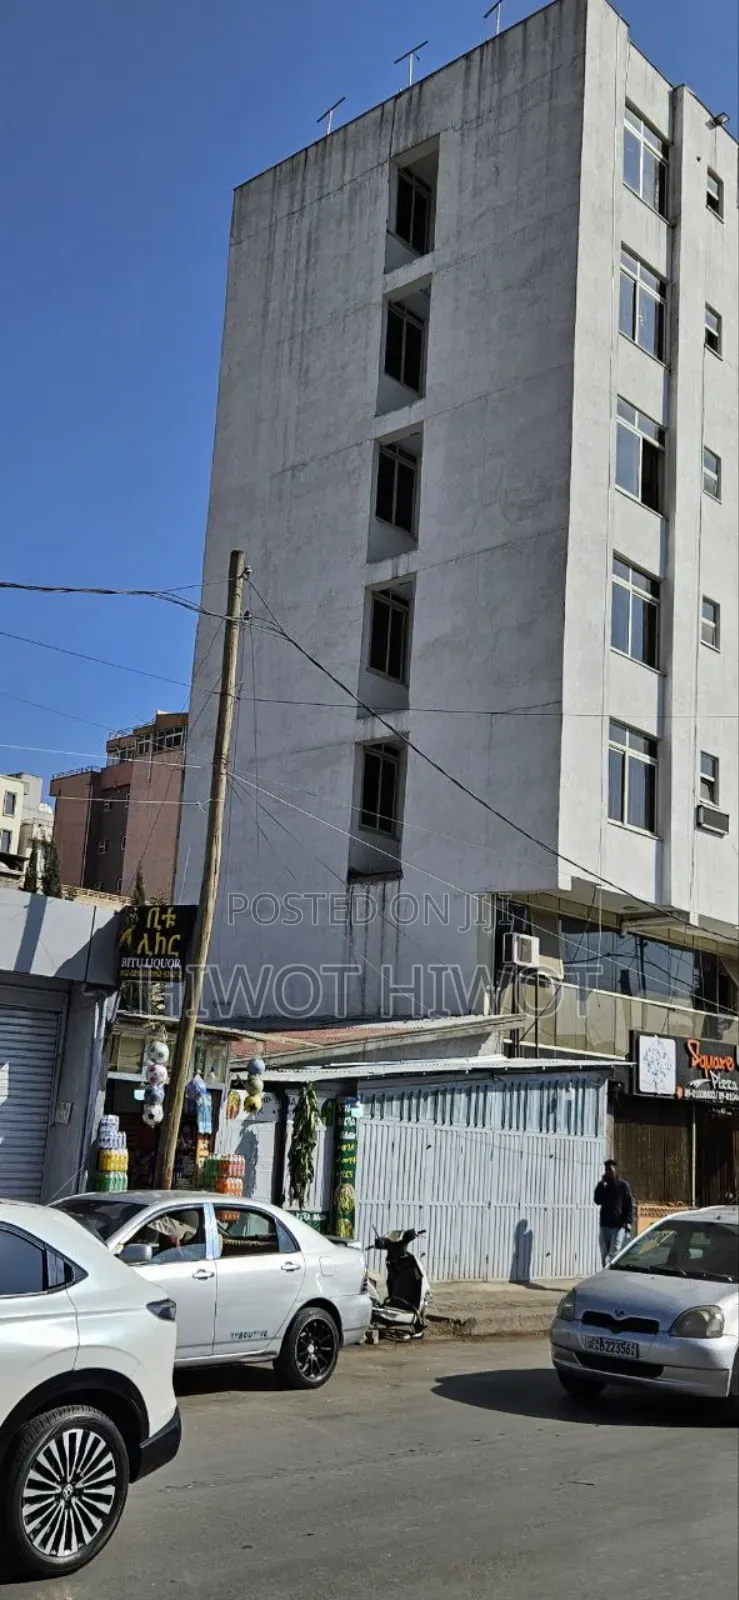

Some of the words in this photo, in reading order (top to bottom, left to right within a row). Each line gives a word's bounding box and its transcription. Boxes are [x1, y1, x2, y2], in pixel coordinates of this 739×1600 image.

[121, 957, 144, 968] BITU
[145, 957, 181, 970] LIQUOR
[709, 1069, 738, 1091] Pizza
